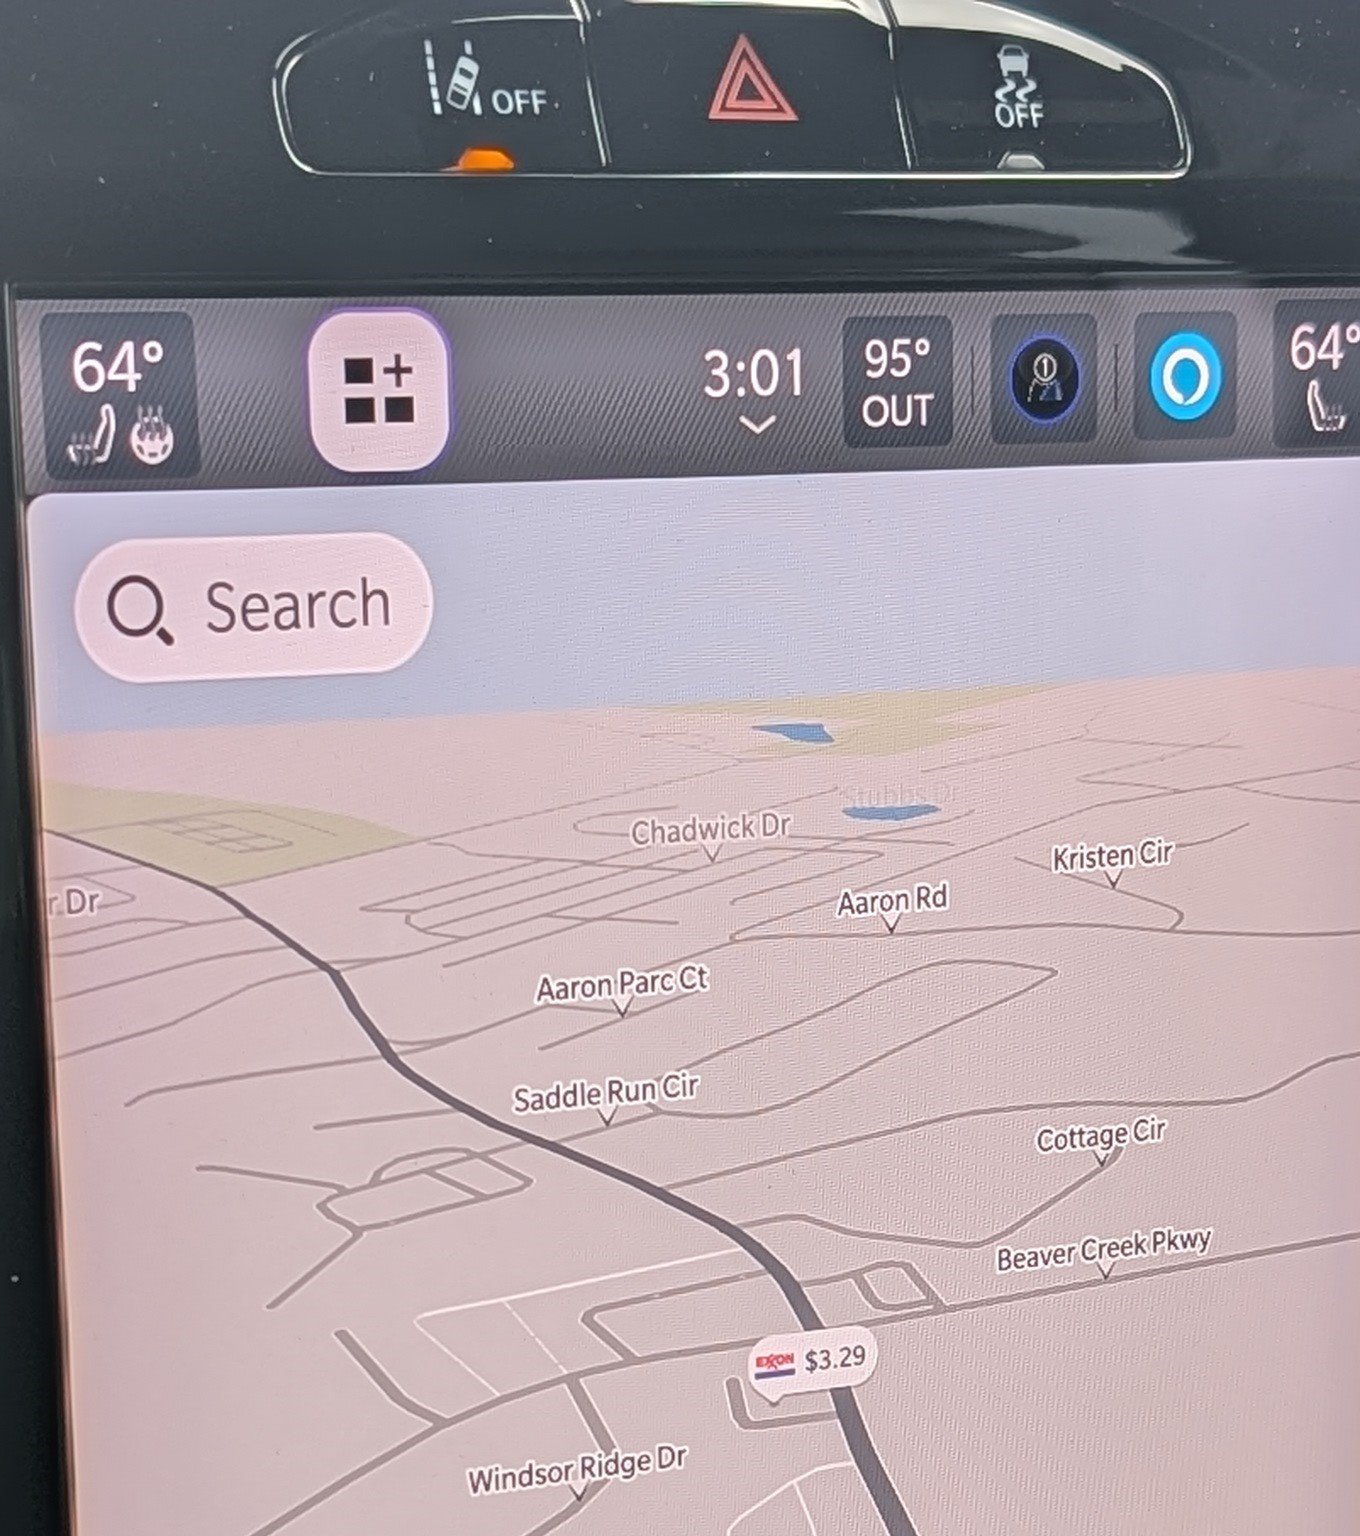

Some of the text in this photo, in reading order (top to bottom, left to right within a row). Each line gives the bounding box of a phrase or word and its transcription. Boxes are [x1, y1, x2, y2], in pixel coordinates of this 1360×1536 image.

[491, 86, 548, 116] OFF
[994, 101, 1044, 130] OFF
[71, 339, 165, 396] 64°
[703, 348, 806, 399] 3:01
[863, 337, 932, 382] 95°
[861, 391, 934, 430] OUT
[206, 577, 392, 637] Search
[632, 813, 790, 845] Chadwick Dr
[1053, 841, 1173, 872] Kristen Cir
[67, 889, 99, 914] Dr
[838, 884, 947, 916] Aaron Rd
[537, 966, 707, 1002] Aaron Parc Ct
[515, 1073, 698, 1112] Saddle Run Cir
[1038, 1118, 1166, 1153] Cottage Cir
[998, 1230, 1211, 1271] Beaver Creek Pkwy
[805, 1345, 865, 1374] $3.29
[469, 1446, 687, 1493] Windsor Ridge Dr
